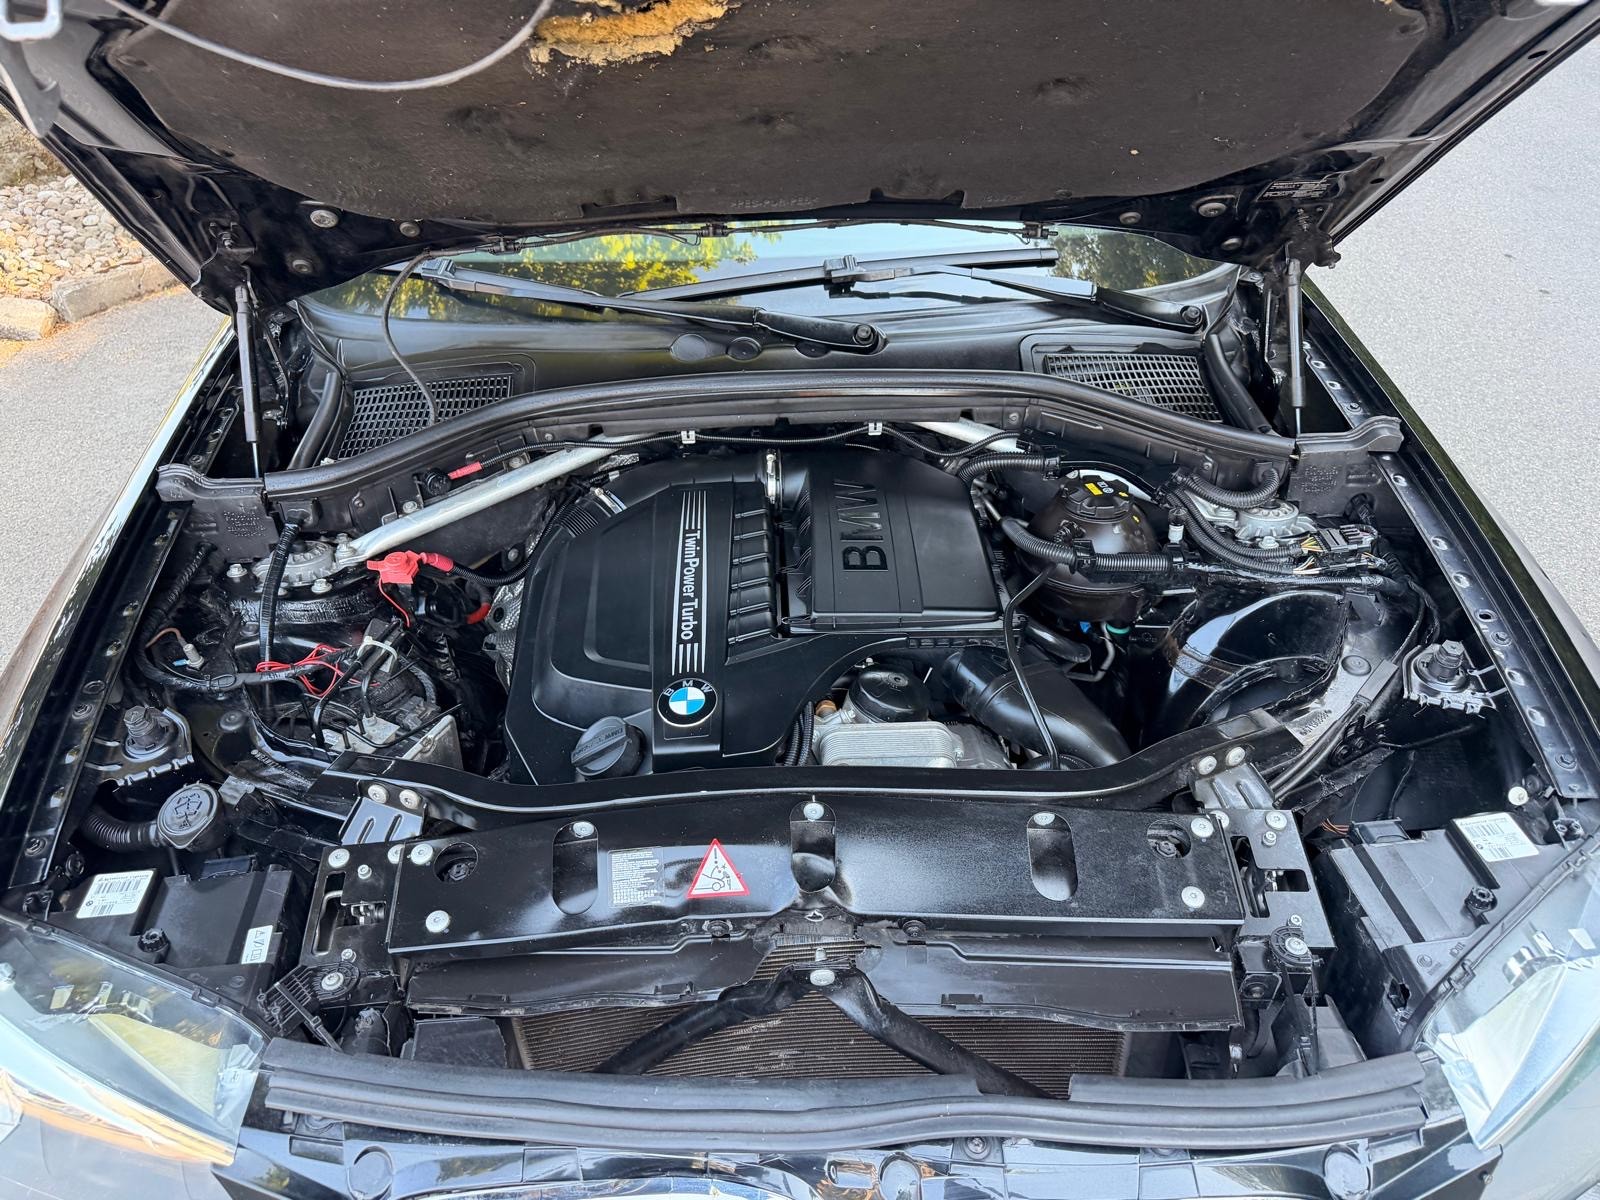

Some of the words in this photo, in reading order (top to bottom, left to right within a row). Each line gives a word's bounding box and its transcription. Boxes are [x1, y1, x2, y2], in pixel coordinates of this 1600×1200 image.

[834, 482, 888, 571] BMW
[683, 530, 701, 597] TwinPower
[681, 598, 699, 640] Turbo
[663, 680, 713, 697] BMW
